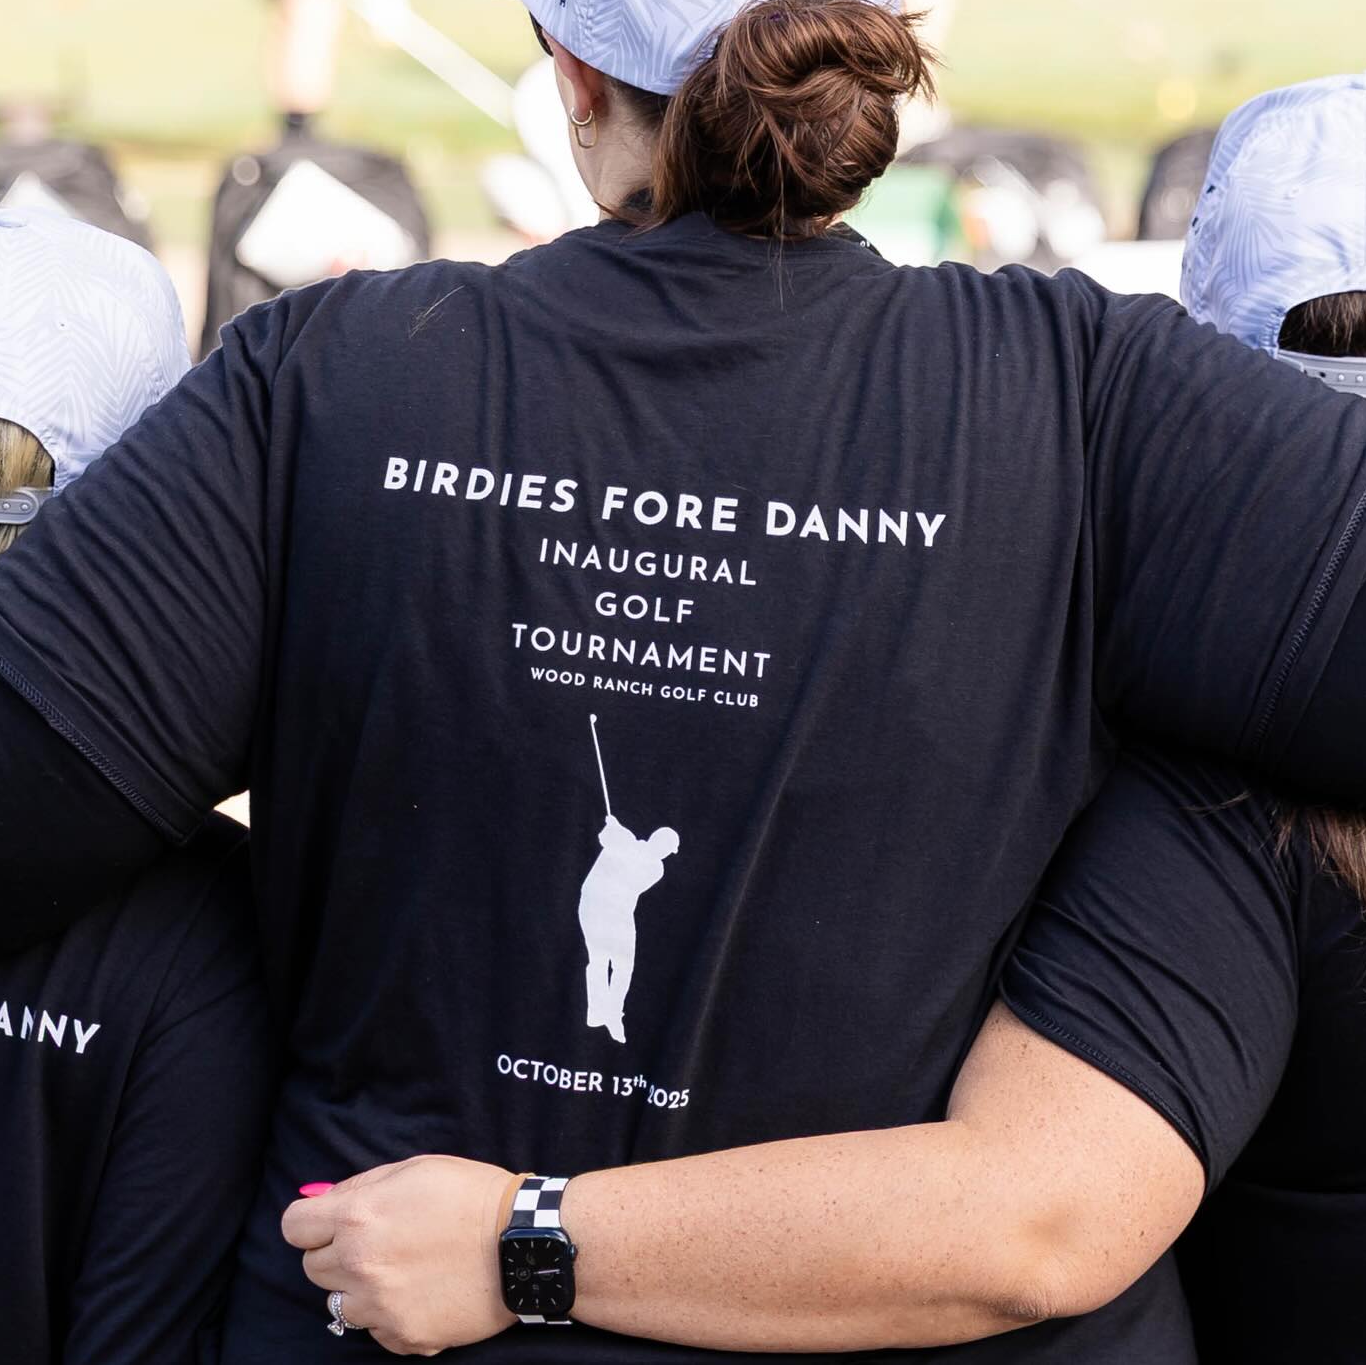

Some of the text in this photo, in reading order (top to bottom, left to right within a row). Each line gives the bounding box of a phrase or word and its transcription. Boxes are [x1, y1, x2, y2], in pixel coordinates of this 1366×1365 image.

[383, 456, 947, 549] BIRDIES FORE DANNY
[539, 537, 757, 586] INAUGURAL
[594, 591, 695, 624] GOLF
[511, 623, 771, 679] TOURNAMENT
[530, 666, 759, 709] WOOD RANCH GOLF CLUB
[497, 1054, 603, 1093] OCTOBER
[612, 1074, 647, 1097] 13th
